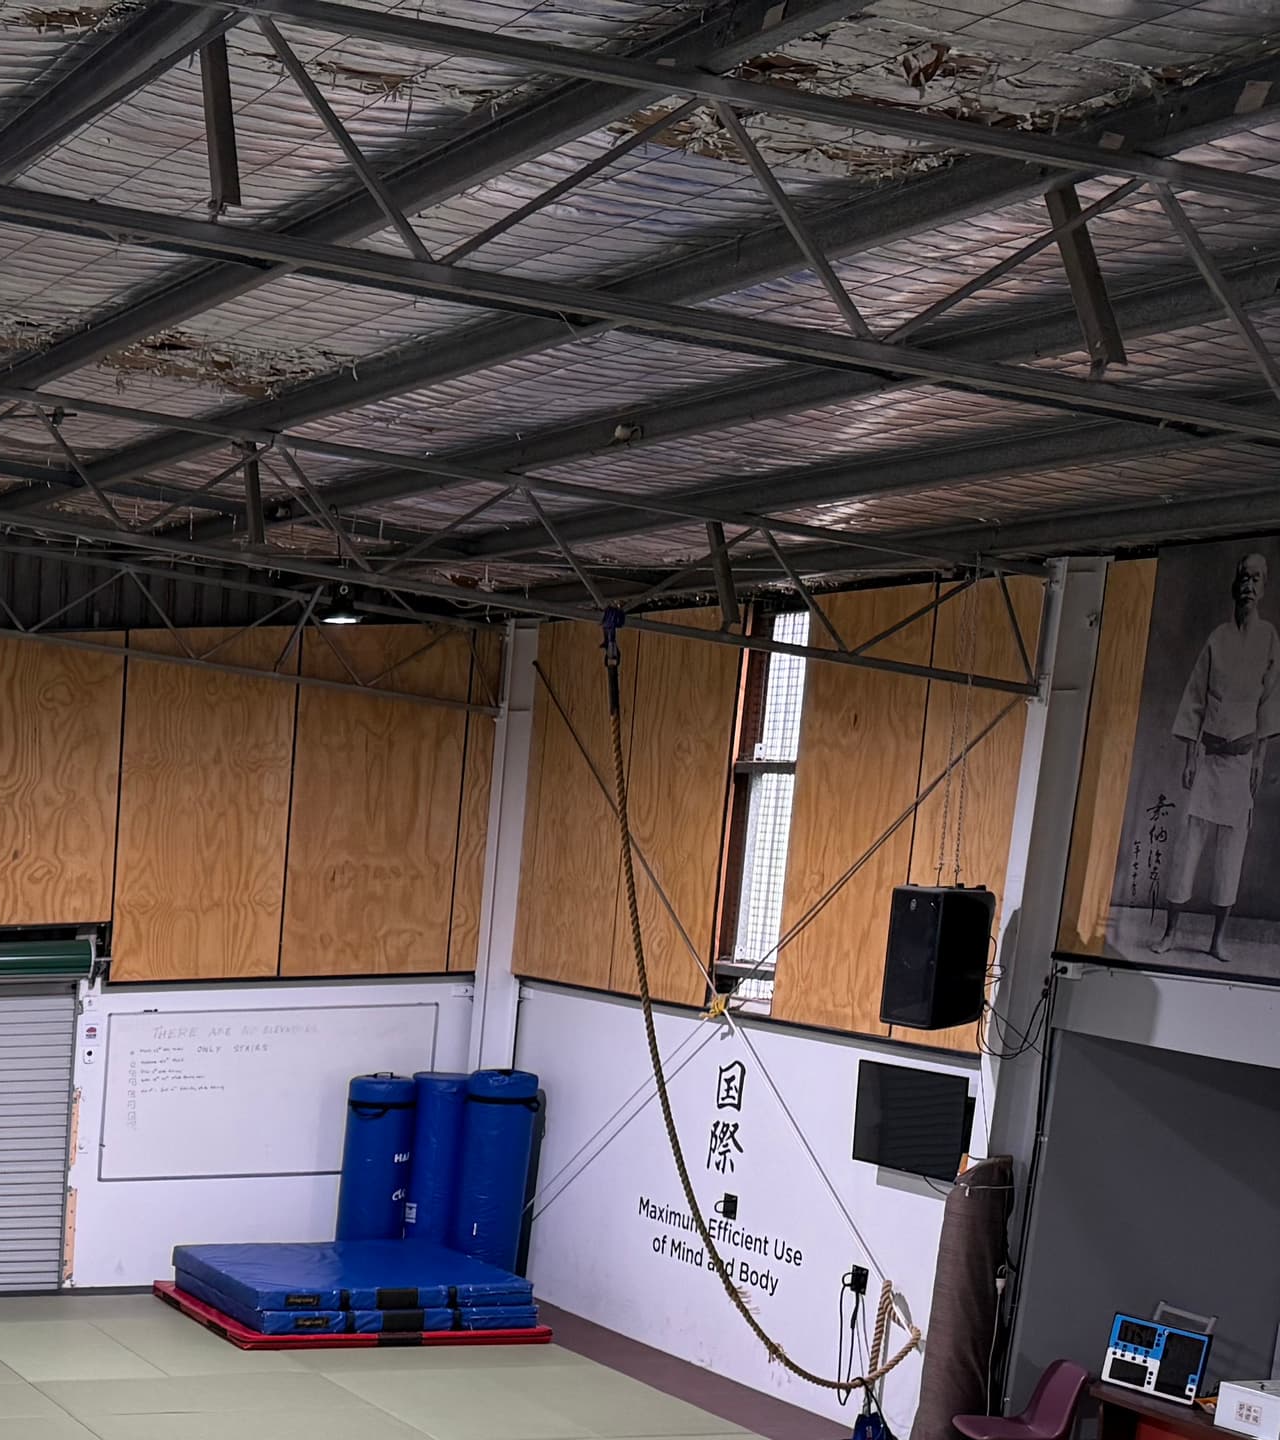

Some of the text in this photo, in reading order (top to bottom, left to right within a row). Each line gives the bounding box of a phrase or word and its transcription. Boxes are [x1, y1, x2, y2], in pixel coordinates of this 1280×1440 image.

[707, 1060, 746, 1174] 国際
[652, 1234, 667, 1253] of
[670, 1240, 704, 1267] Mind
[740, 1262, 778, 1296] Body
[708, 1218, 769, 1257] Efficient
[774, 1238, 802, 1266] Use
